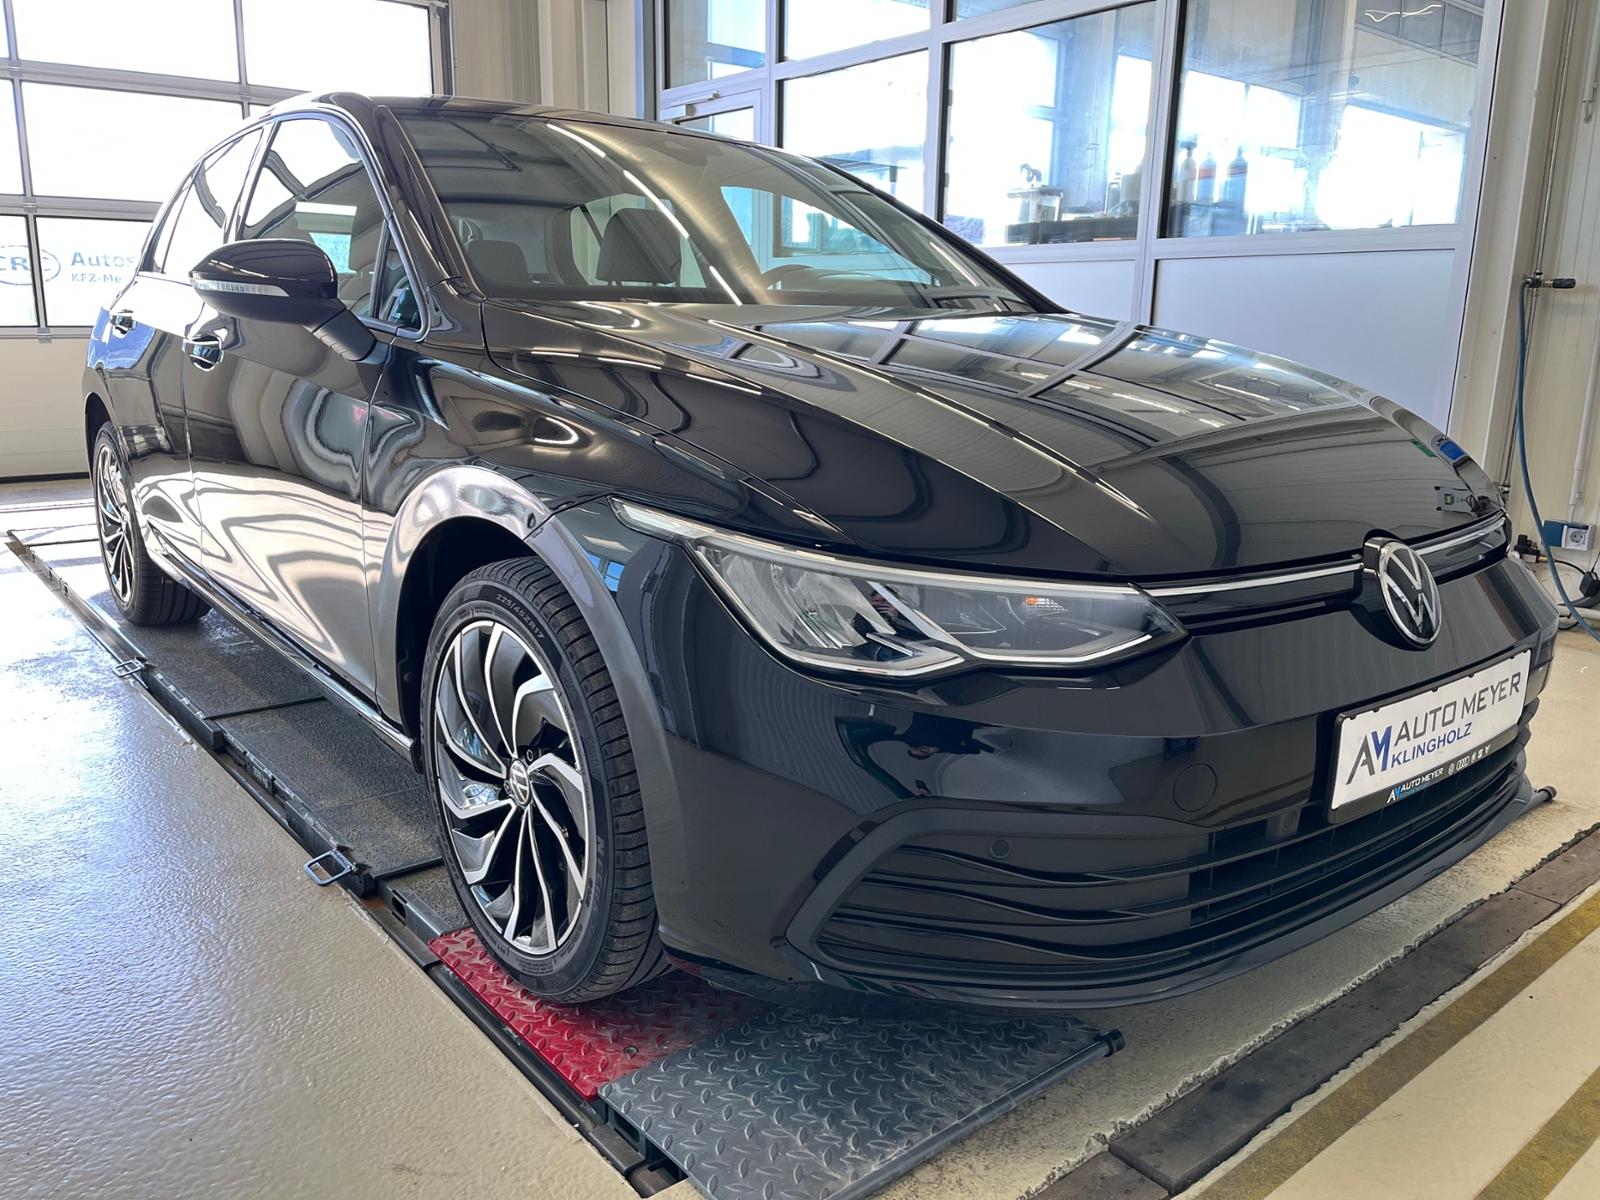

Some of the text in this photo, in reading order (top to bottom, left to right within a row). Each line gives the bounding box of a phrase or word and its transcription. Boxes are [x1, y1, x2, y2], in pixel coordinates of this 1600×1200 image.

[1394, 672, 1521, 746] AUTO MEYER
[1391, 722, 1473, 768] KLINGHOLZ
[1400, 779, 1421, 793] AUTO
[1421, 767, 1445, 783] MEYER
